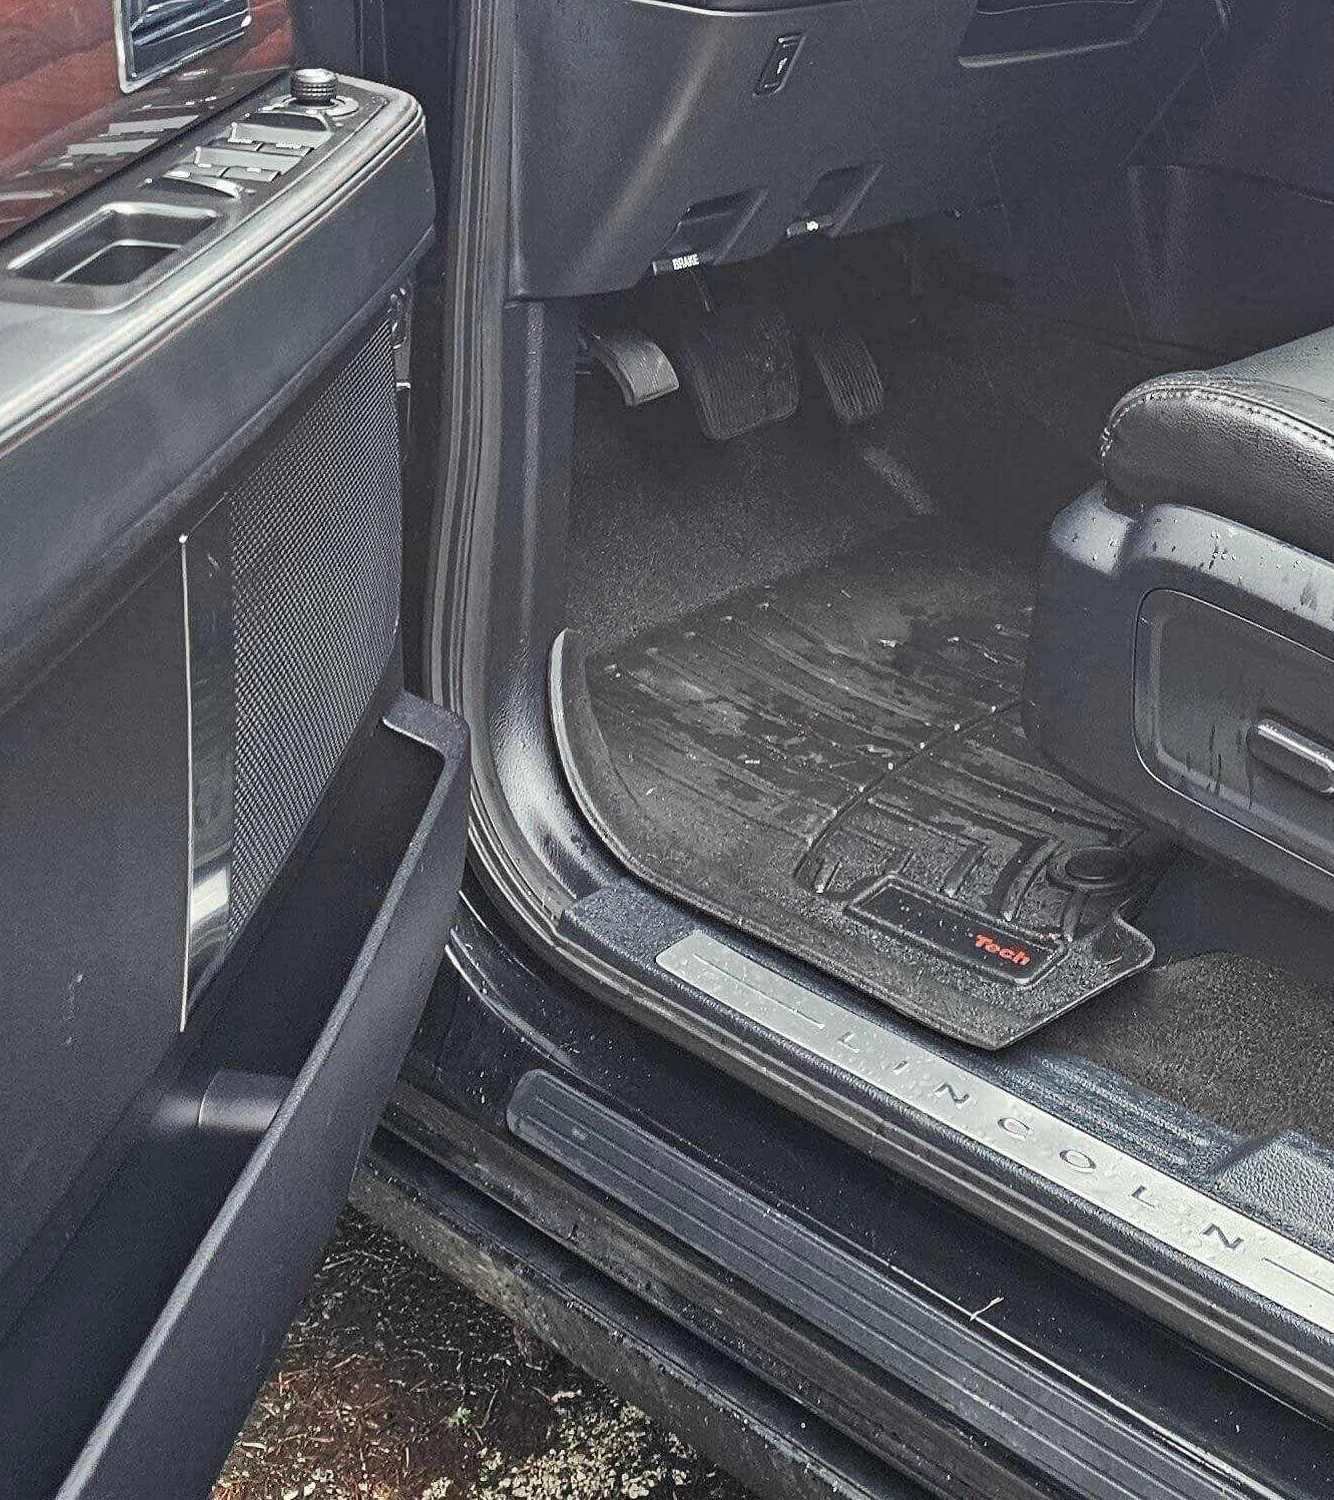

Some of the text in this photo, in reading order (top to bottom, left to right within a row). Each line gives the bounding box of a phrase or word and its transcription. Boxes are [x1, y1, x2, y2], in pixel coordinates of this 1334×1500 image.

[671, 253, 700, 271] BRAKE
[974, 933, 1032, 967] Tech
[838, 1030, 1245, 1251] LINCOLN
